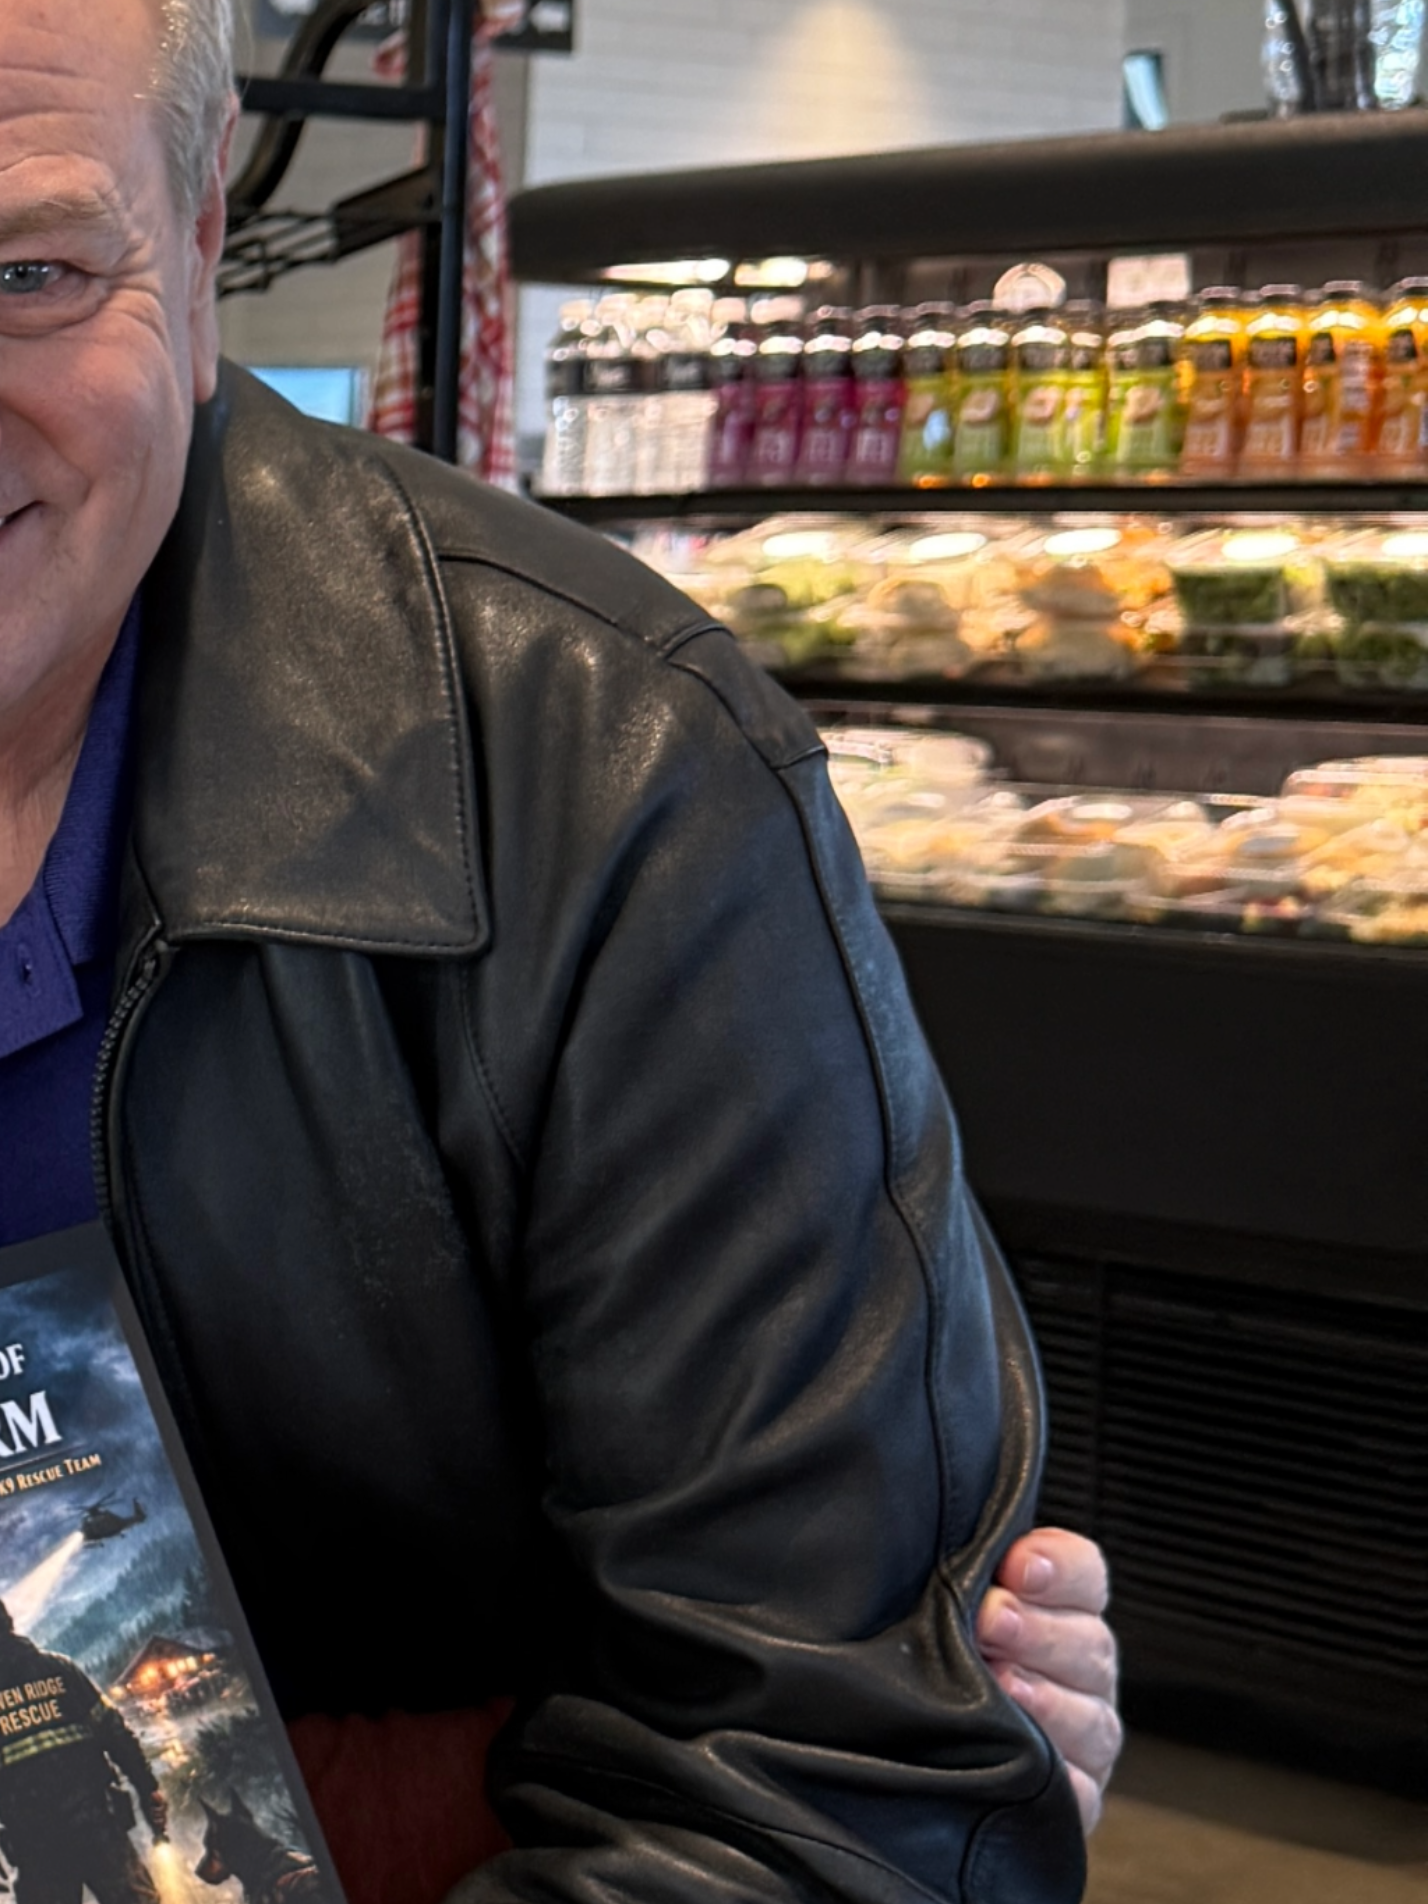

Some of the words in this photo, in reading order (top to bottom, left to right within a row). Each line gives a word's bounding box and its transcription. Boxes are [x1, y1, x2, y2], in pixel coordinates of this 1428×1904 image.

[15, 1464, 64, 1491] RESCUE
[63, 1452, 103, 1476] TEAM
[24, 1676, 66, 1700] RIDGE
